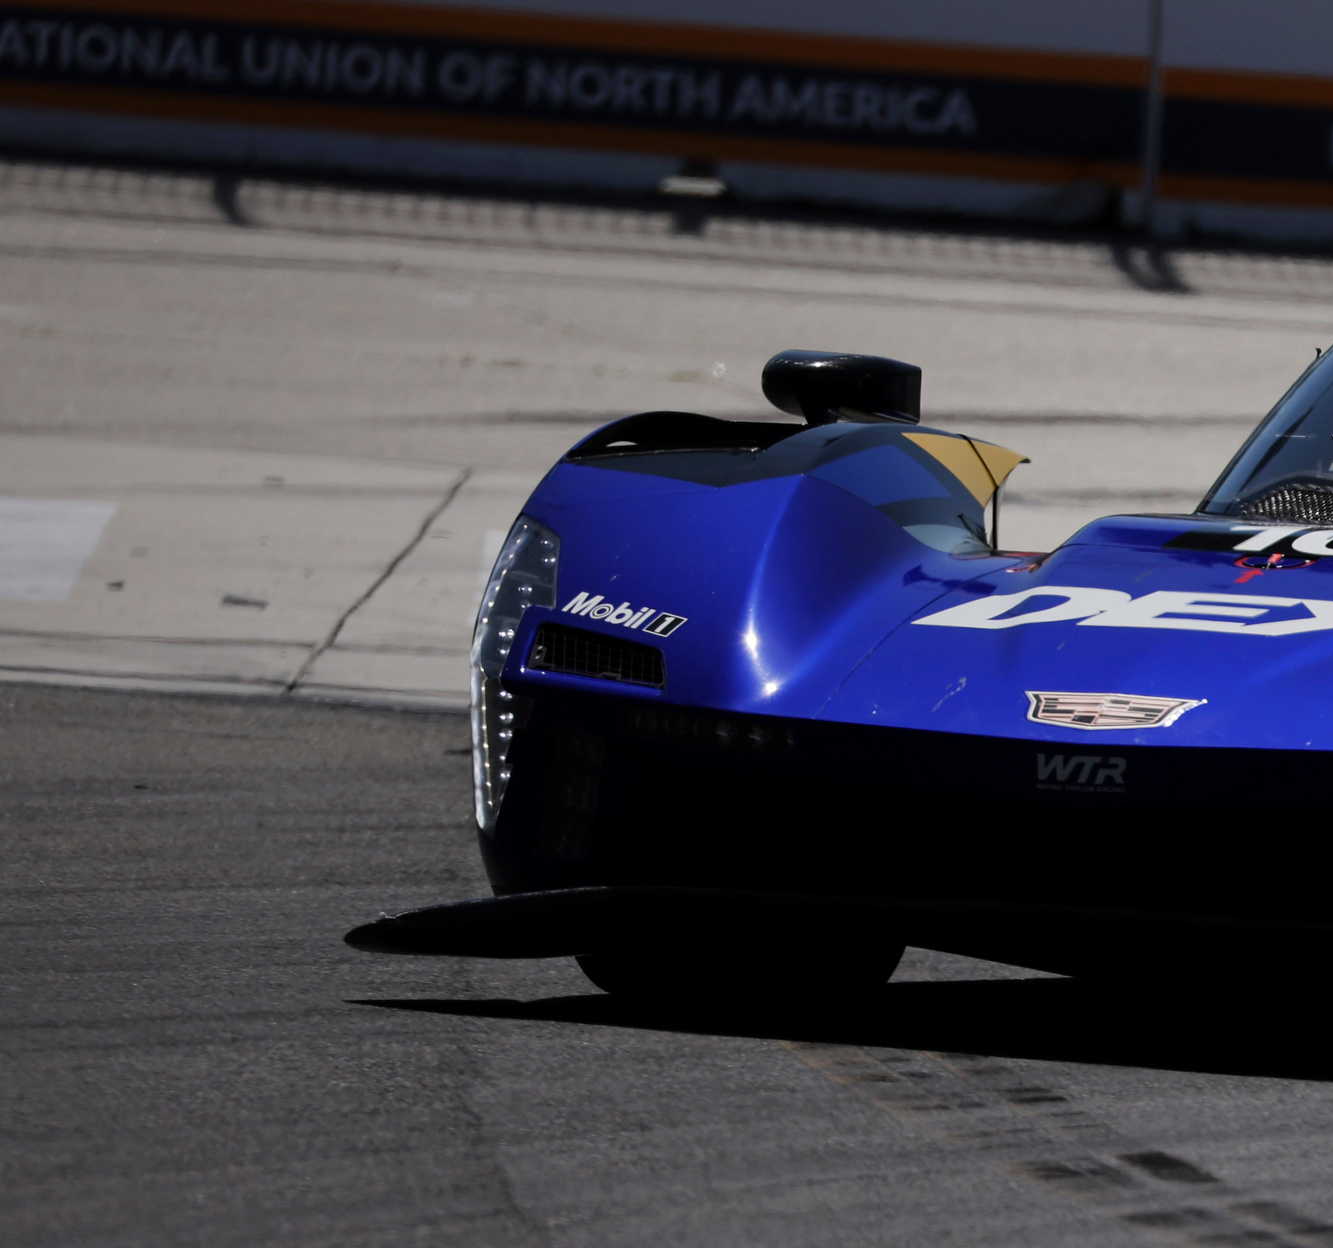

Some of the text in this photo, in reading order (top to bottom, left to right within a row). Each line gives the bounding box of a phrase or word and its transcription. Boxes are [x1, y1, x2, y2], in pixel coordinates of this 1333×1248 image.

[240, 34, 425, 97] UNION
[437, 50, 518, 102] OF
[524, 58, 722, 120] NORTH
[727, 74, 979, 138] AMERICA
[560, 591, 657, 629] Mobil
[1036, 753, 1128, 785] WTR
